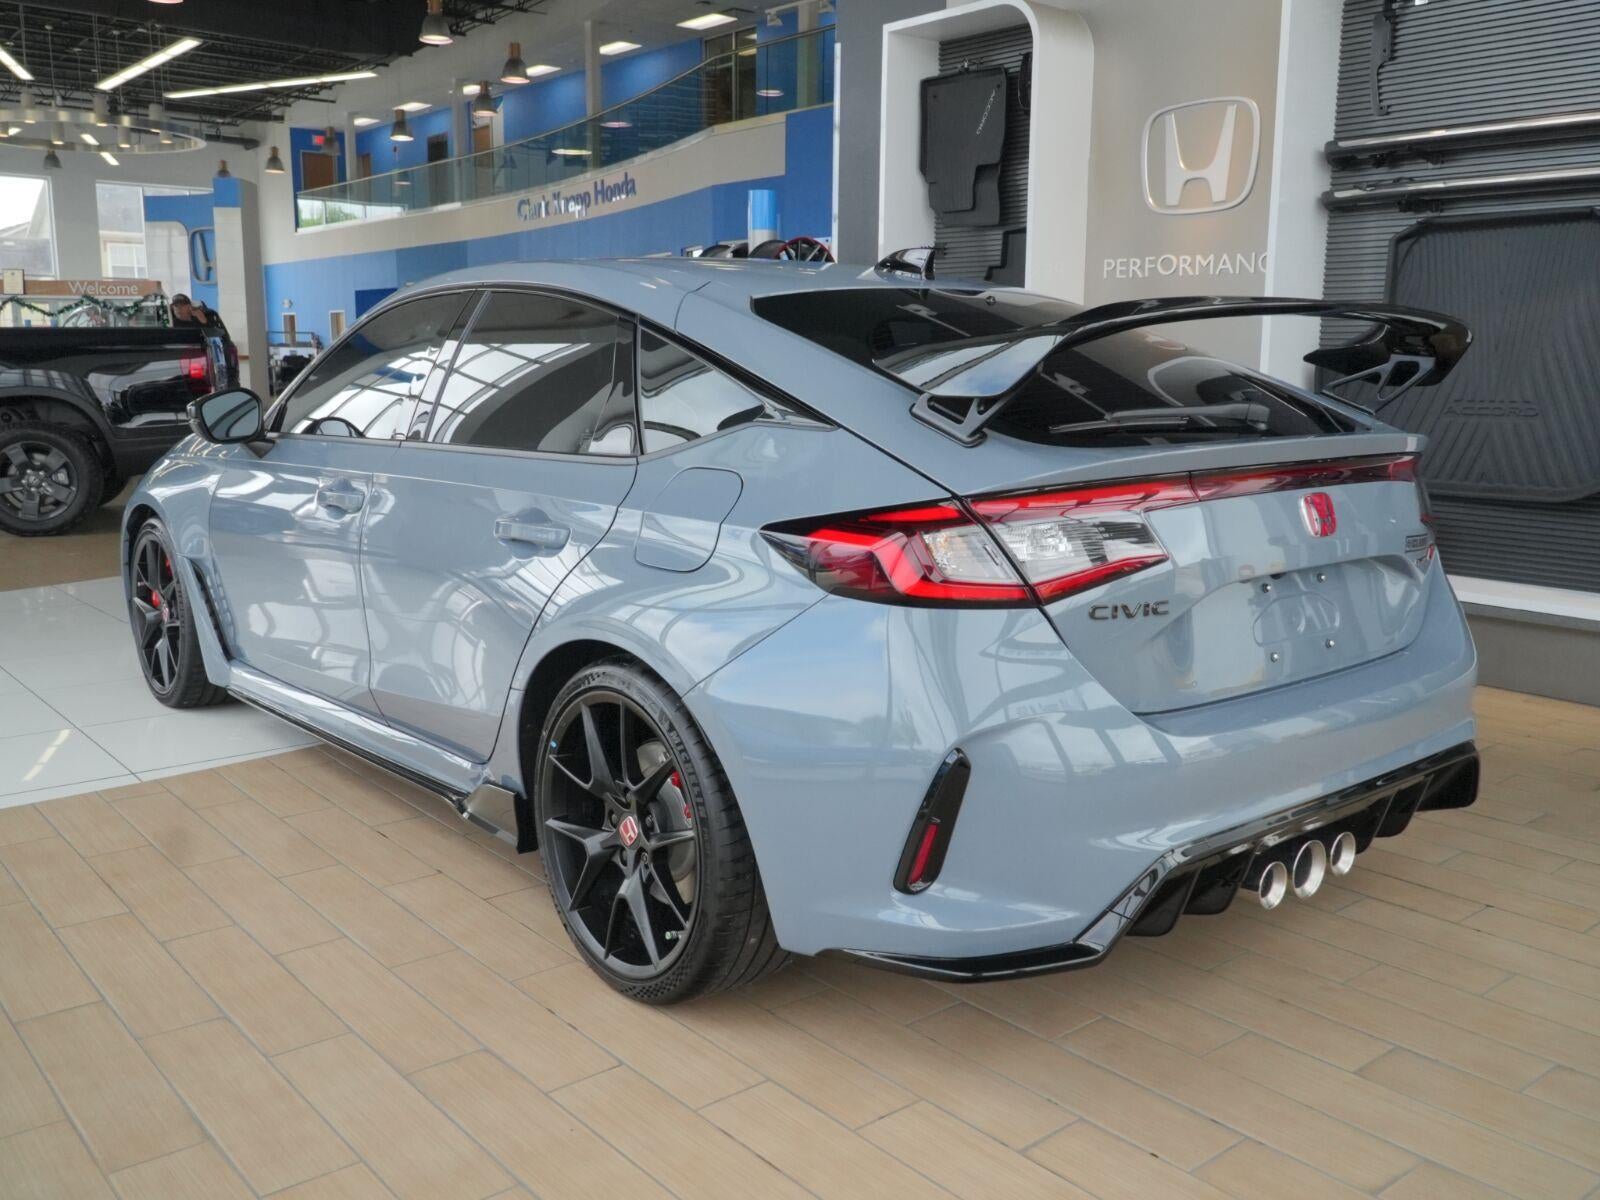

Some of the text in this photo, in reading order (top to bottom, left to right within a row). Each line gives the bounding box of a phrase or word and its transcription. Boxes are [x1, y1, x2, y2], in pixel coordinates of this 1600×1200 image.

[594, 171, 637, 206] Honda
[67, 280, 139, 296] Welcome
[1444, 405, 1540, 418] ACCORD
[1088, 600, 1169, 620] CIVIC
